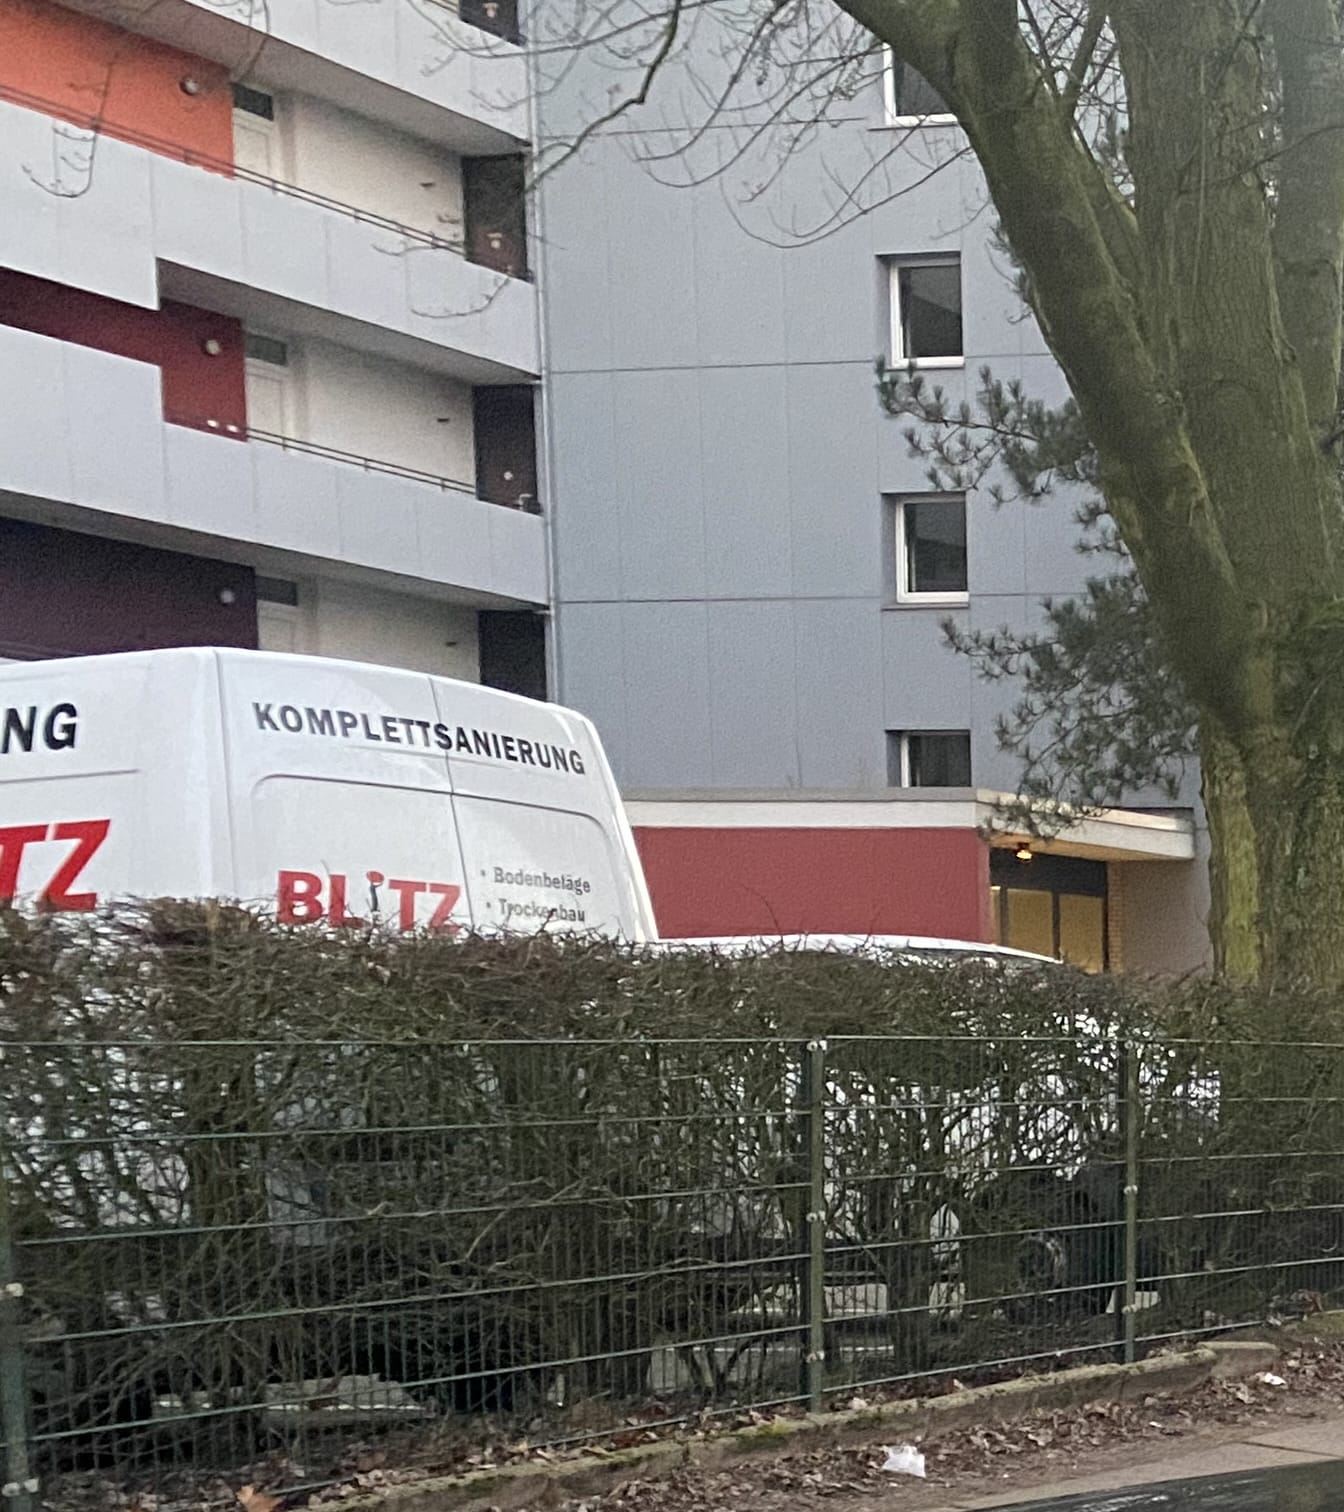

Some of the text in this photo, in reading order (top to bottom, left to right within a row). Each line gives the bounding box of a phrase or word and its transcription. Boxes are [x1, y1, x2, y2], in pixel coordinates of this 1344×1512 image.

[0, 702, 79, 754] NG
[254, 701, 586, 776] KOMPLETTSANIERUNG
[493, 866, 592, 896] Bodenbeläge
